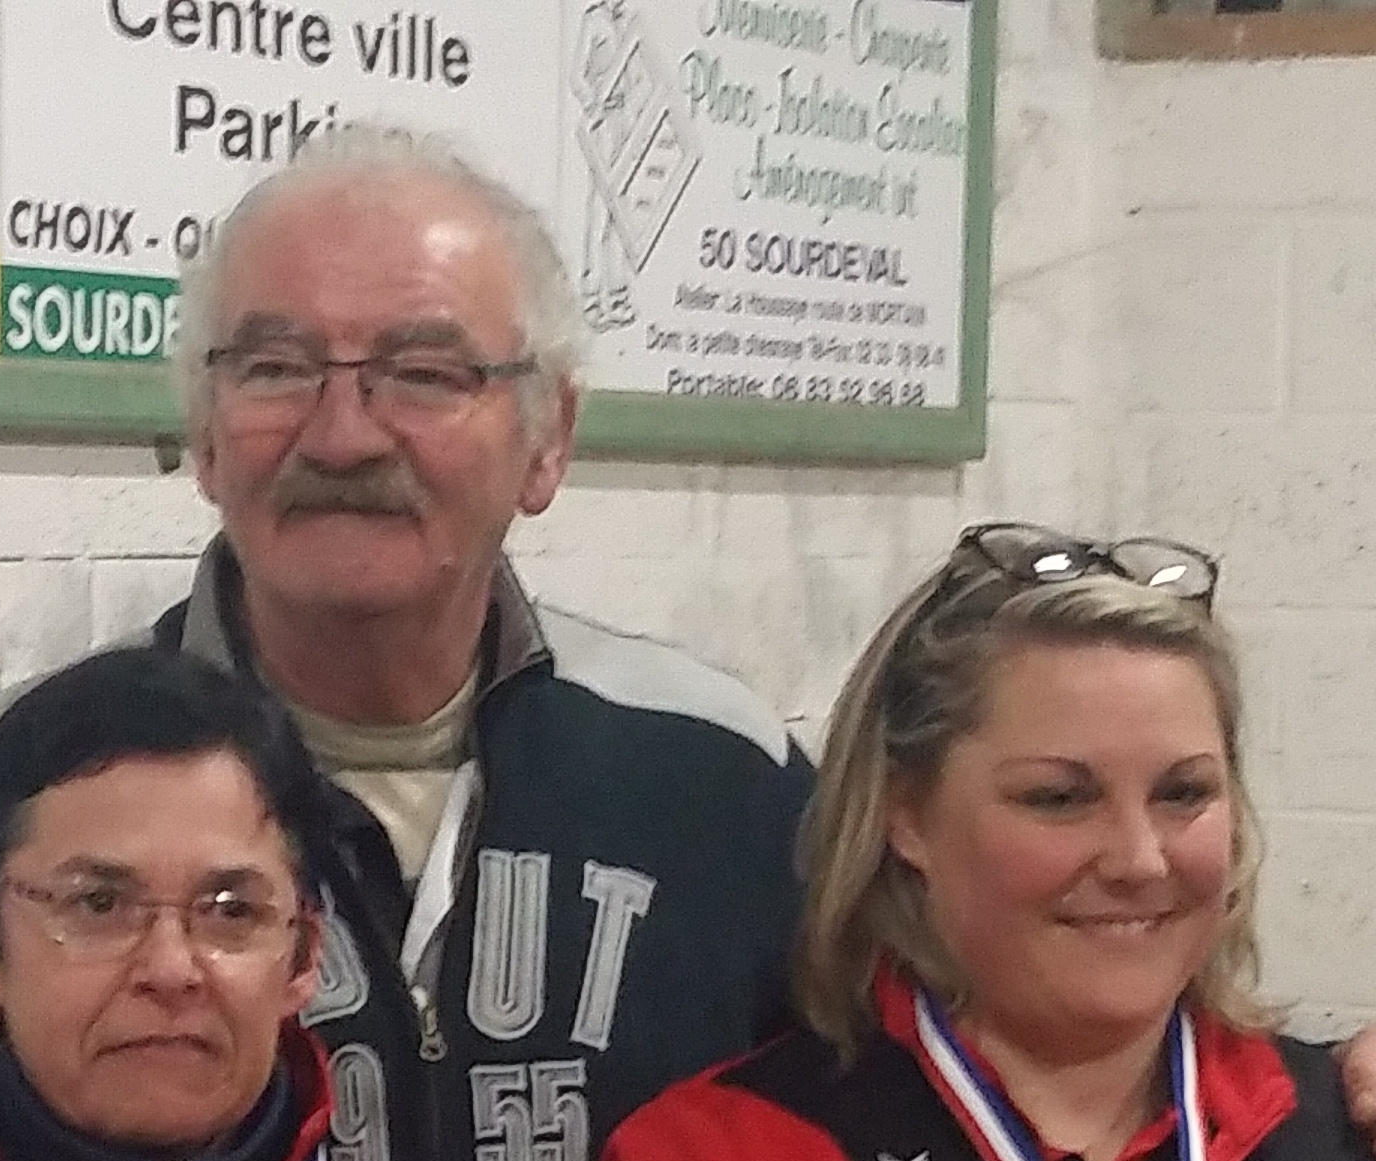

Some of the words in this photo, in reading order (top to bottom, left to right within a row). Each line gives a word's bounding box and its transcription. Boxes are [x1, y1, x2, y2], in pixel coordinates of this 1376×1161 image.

[107, 0, 332, 66] Centre
[353, 14, 472, 87] ville
[10, 199, 136, 256] CHOIX
[699, 227, 736, 271] 50
[745, 229, 908, 286] SOURDEVAL
[5, 282, 183, 356] SOURDE
